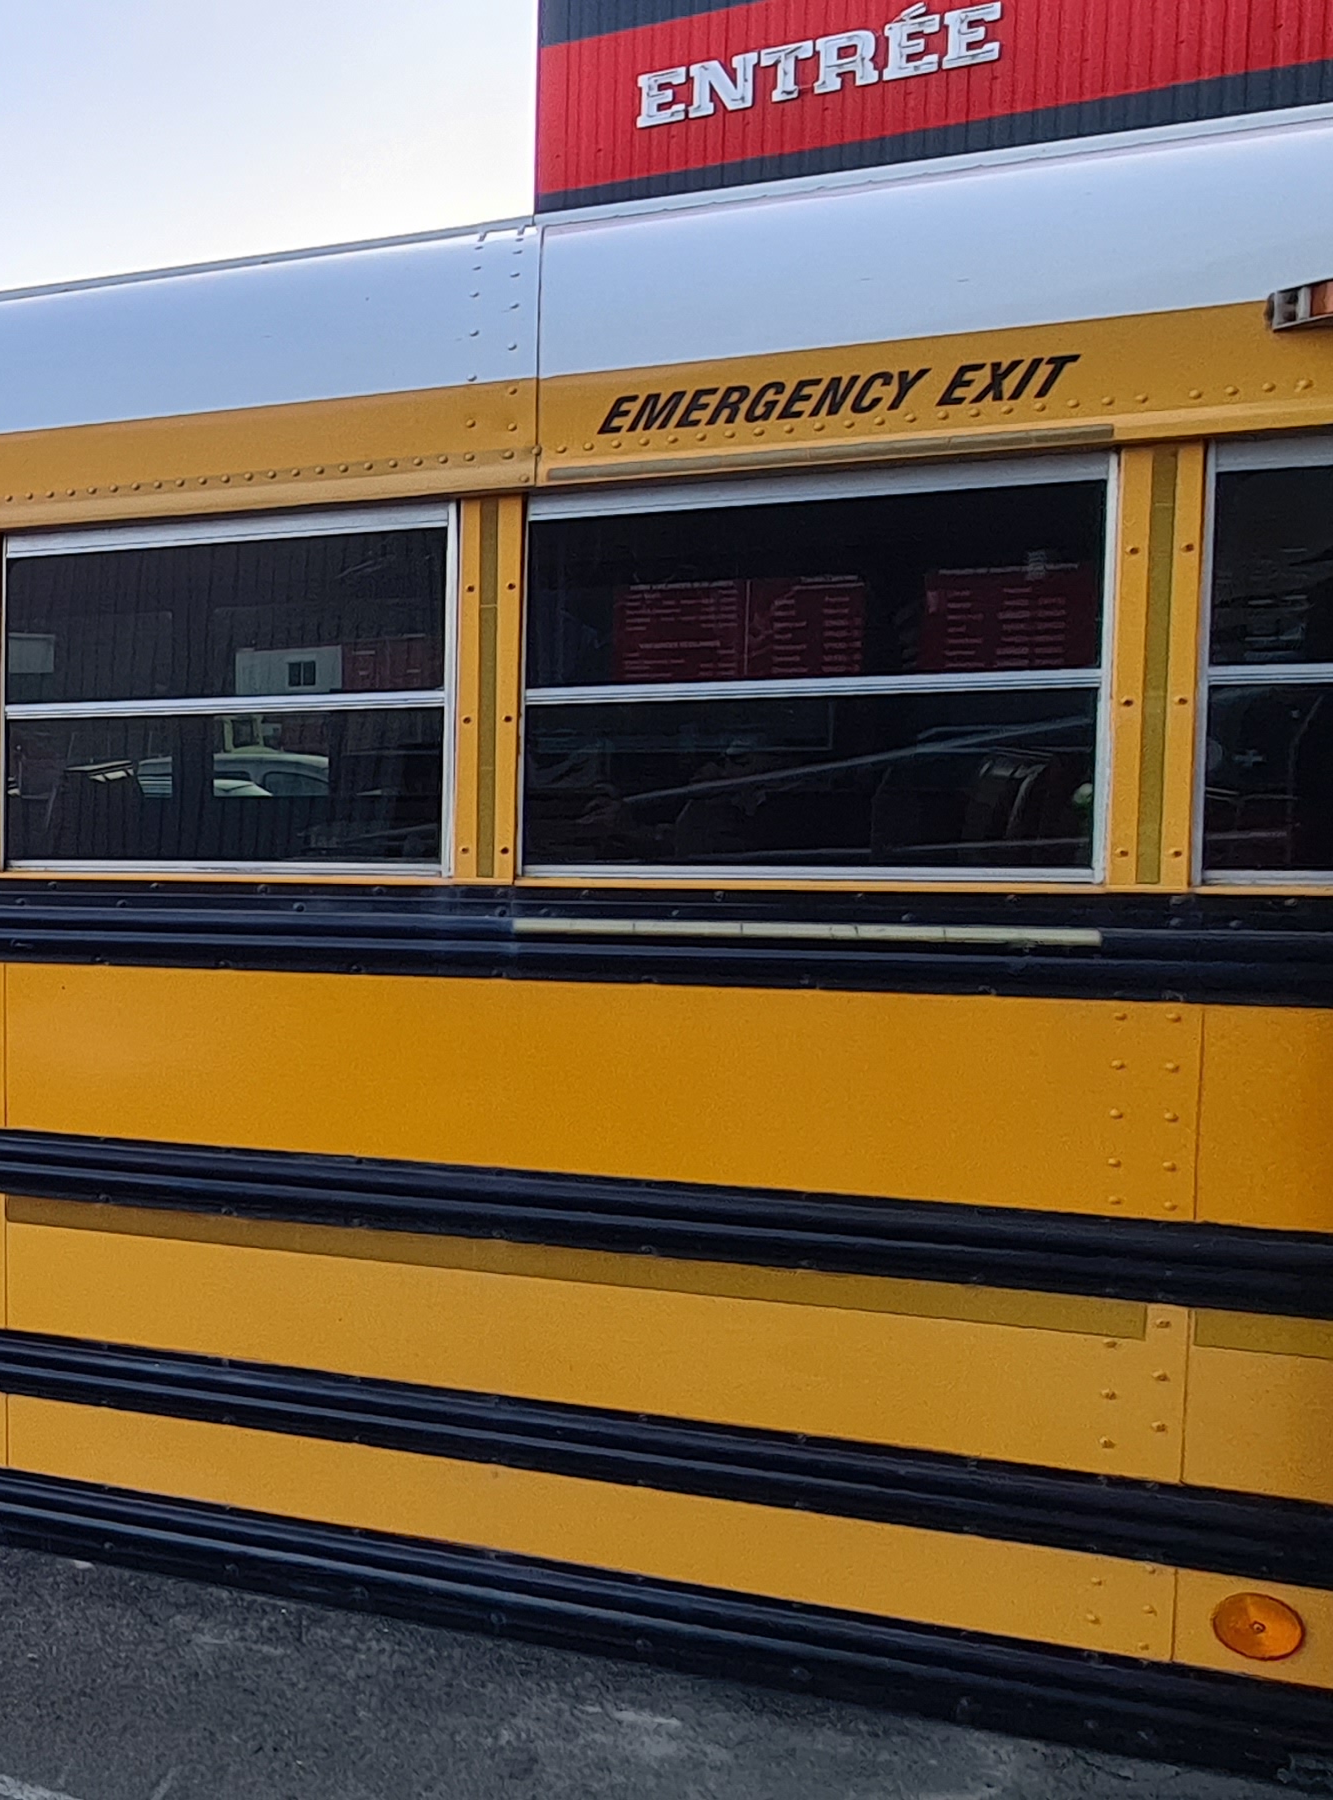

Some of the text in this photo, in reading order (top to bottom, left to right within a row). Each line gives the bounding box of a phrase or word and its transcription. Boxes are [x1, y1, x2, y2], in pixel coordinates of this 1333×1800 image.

[636, 1, 1002, 129] ENTRÉE
[597, 354, 1081, 435] EMERGENCY EXIT
